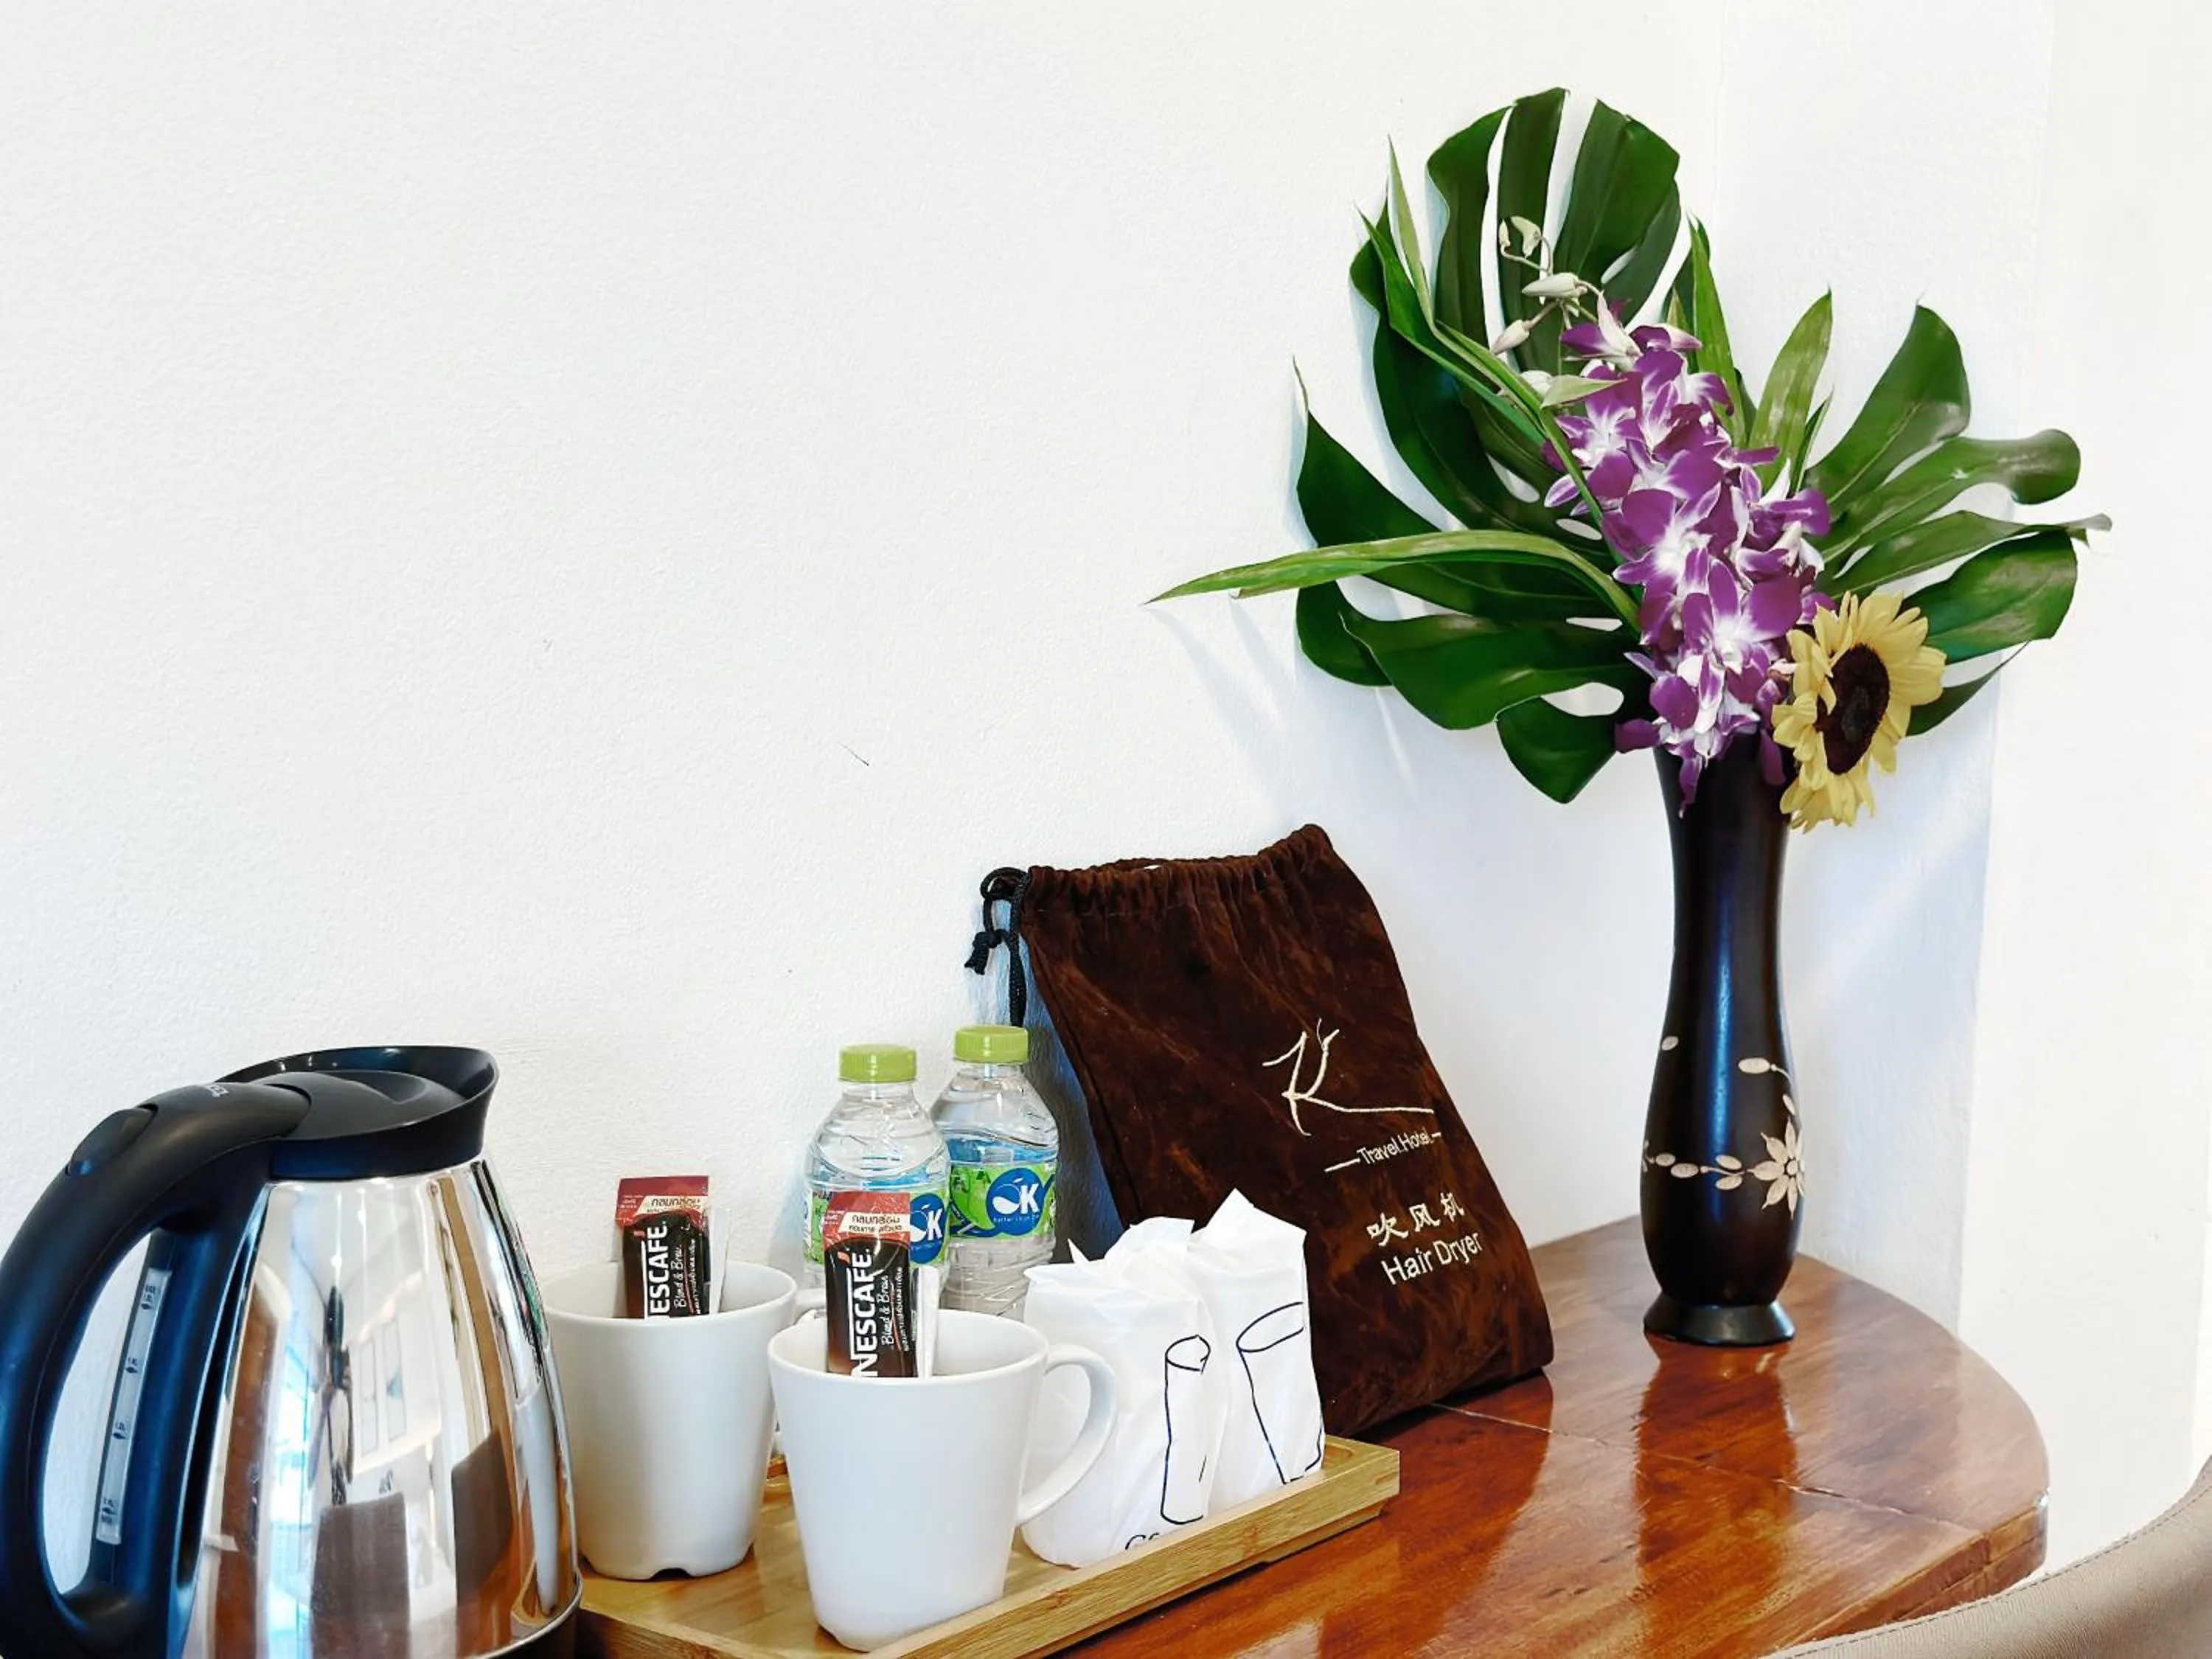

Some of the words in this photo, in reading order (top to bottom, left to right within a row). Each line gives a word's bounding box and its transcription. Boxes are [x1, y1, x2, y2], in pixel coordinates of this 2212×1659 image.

[1357, 1137, 1400, 1165] Travel
[1399, 1126, 1431, 1152] Hotel
[1366, 1192, 1464, 1246] 吹风机
[674, 1272, 684, 1281] &
[1381, 1248, 1433, 1284] Hair
[1433, 1232, 1483, 1265] Dryer
[879, 1306, 891, 1315] &
